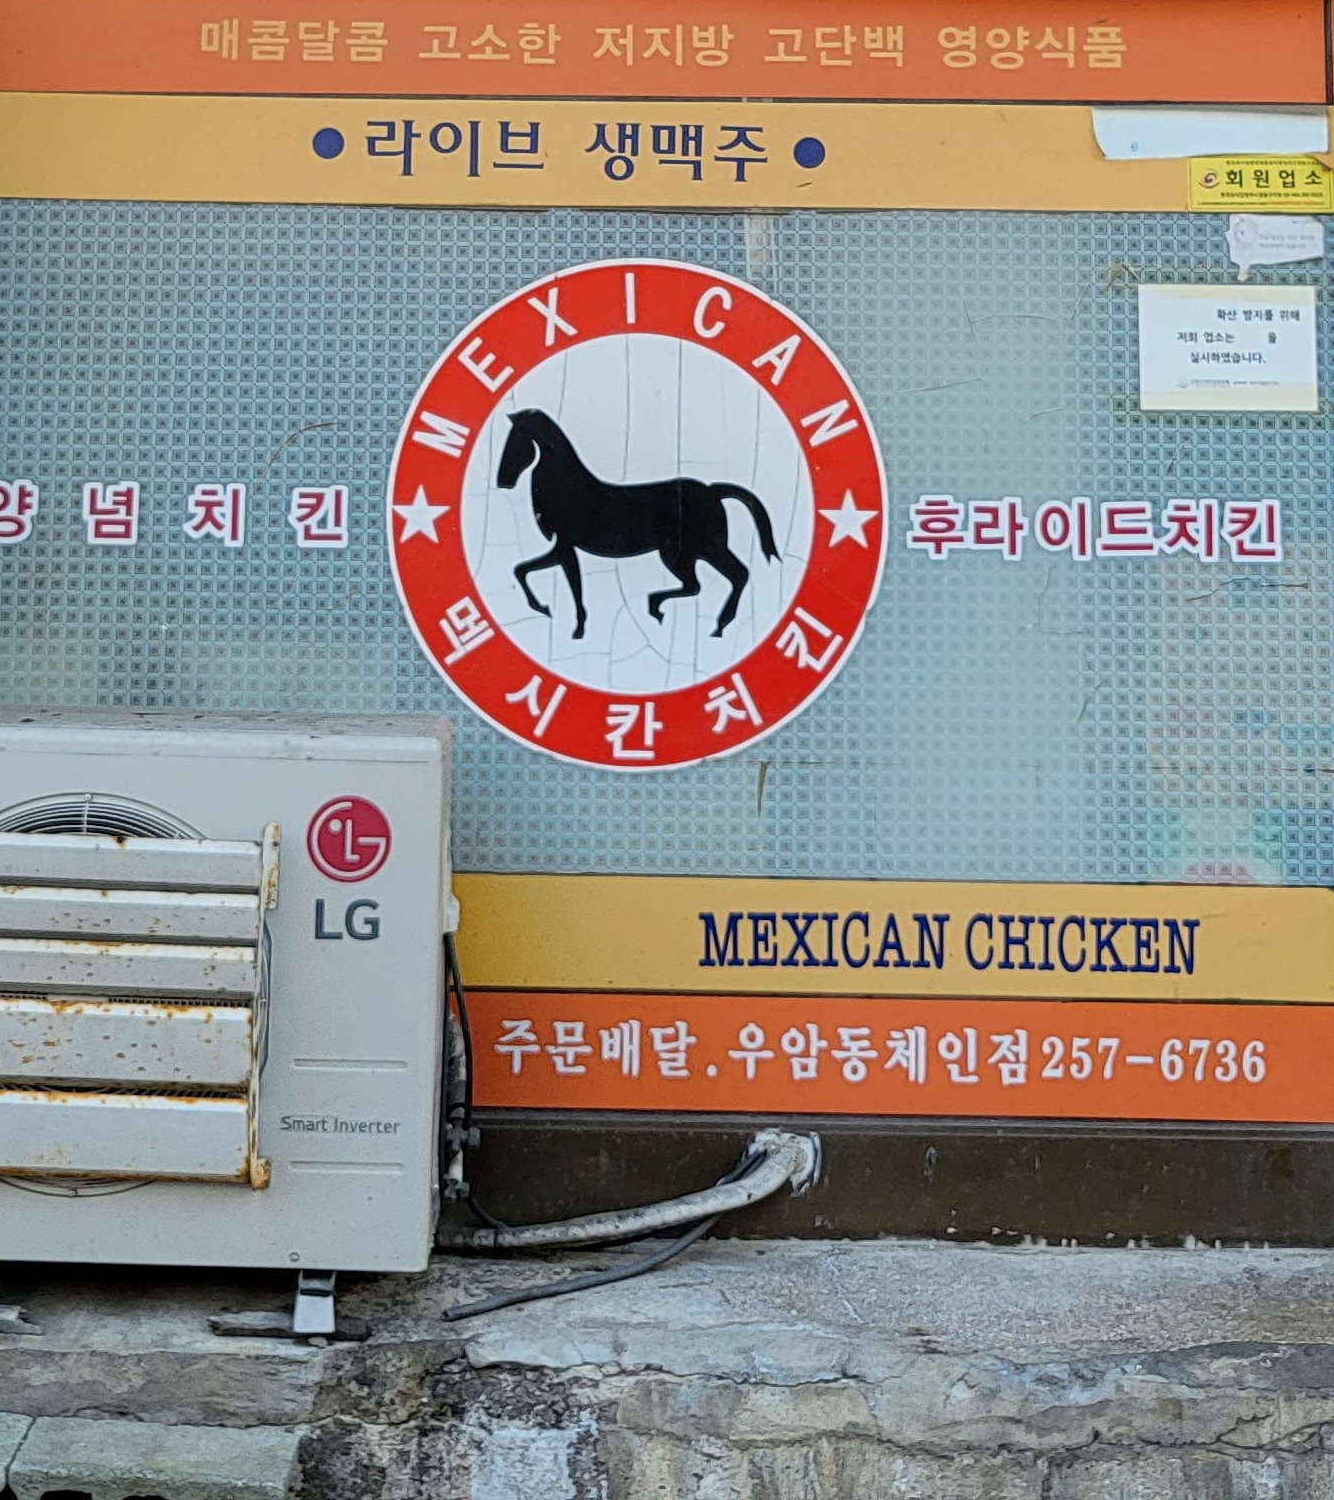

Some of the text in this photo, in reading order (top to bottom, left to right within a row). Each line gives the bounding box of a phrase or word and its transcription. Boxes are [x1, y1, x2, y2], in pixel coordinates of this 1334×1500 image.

[200, 19, 1128, 70] 매콤달콤 고소한 저지방 고단백 영양식품
[364, 118, 769, 183] 라이브 생맥주
[1176, 331, 1198, 344] 저희
[1203, 331, 1236, 344] 업소는
[1216, 308, 1300, 322] 확산 방지를 위해
[412, 272, 859, 458] MEXICAN
[908, 495, 1284, 562] 후라이드치킨
[440, 601, 845, 760] 멕시칸치킨
[314, 898, 381, 941] LG
[697, 911, 1201, 975] MEXICAN CHICKEN
[279, 1114, 402, 1135] Smart Inverter
